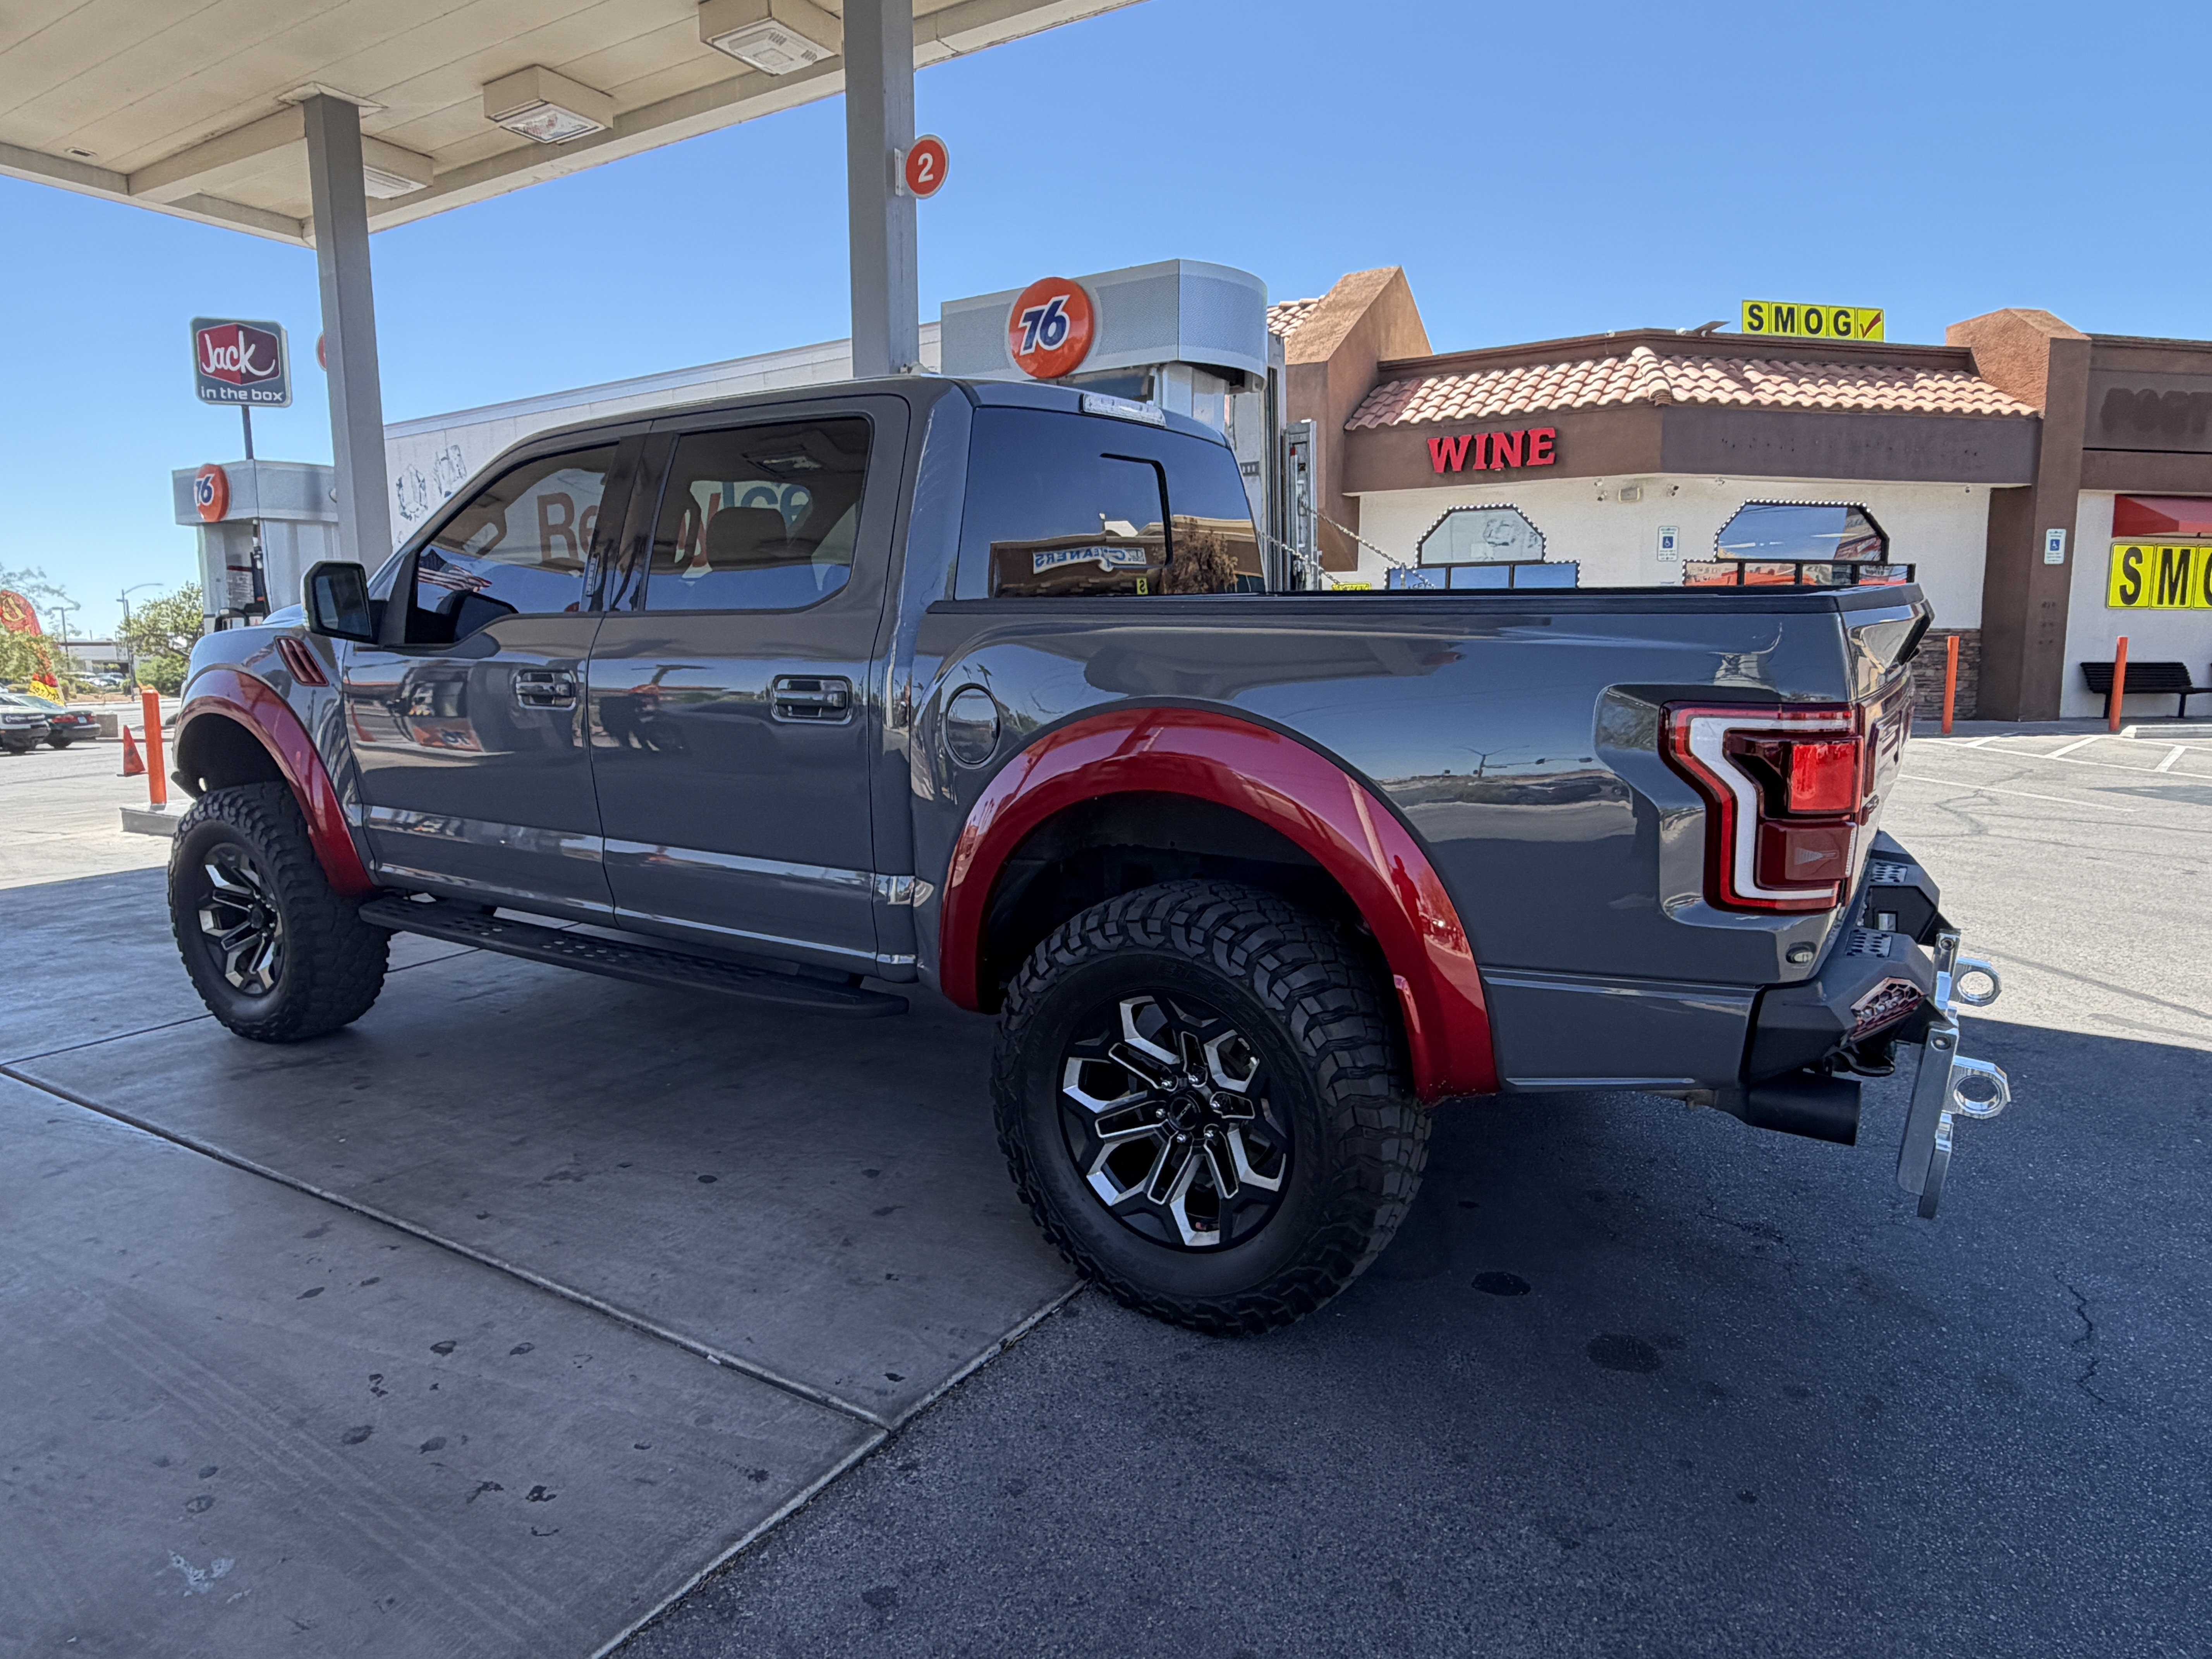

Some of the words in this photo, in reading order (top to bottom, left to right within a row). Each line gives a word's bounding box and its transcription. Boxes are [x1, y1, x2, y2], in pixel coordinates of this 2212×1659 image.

[917, 153, 933, 183] 2
[1018, 295, 1070, 356] 76
[1747, 304, 1851, 336] SMOG
[202, 330, 275, 376] Jack
[201, 386, 216, 399] in
[220, 387, 248, 400] the
[251, 389, 283, 402] box
[1427, 428, 1556, 473] WINE
